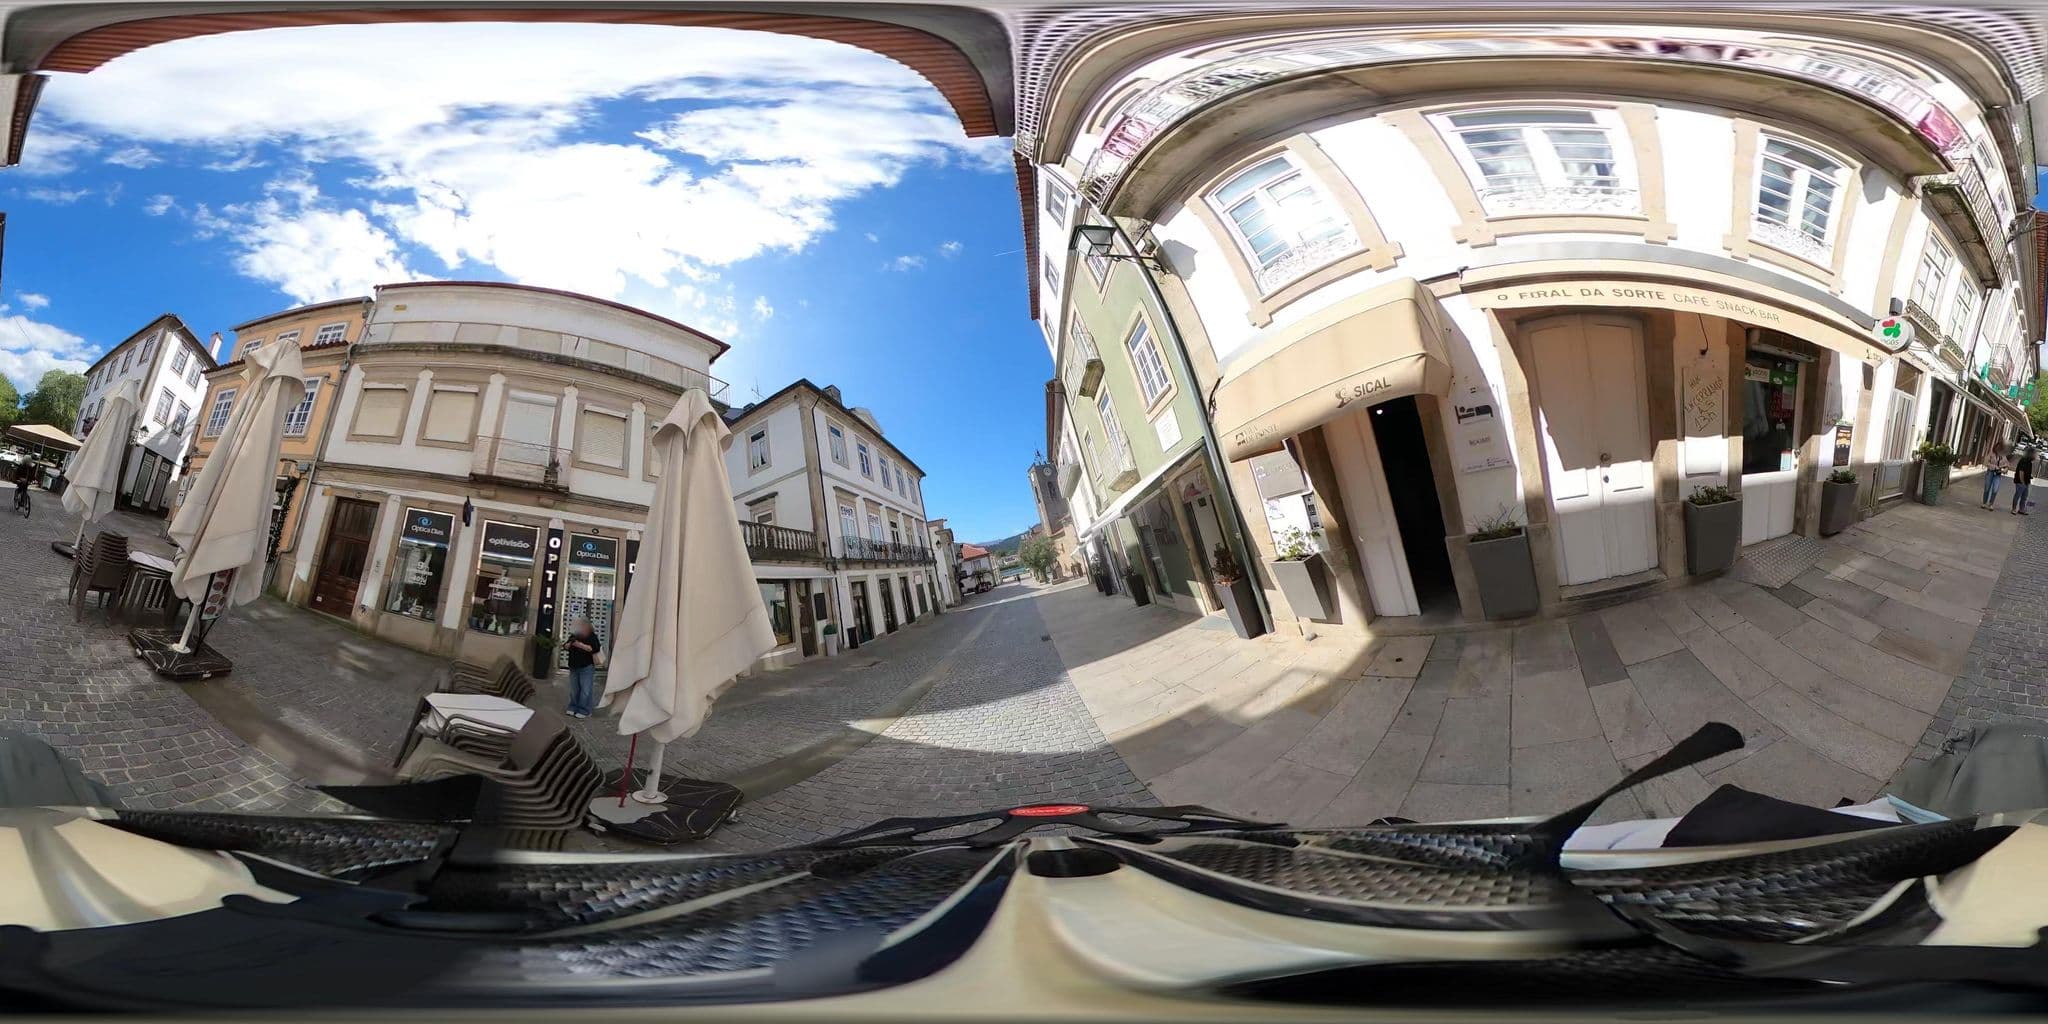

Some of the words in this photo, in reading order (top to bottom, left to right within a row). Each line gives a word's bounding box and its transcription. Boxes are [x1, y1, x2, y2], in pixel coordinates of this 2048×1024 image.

[1580, 288, 1605, 297] DA
[1612, 288, 1666, 301] SORTE
[1716, 300, 1757, 317] SNACK
[1758, 308, 1781, 324] BAR
[1353, 376, 1392, 398] SICAL
